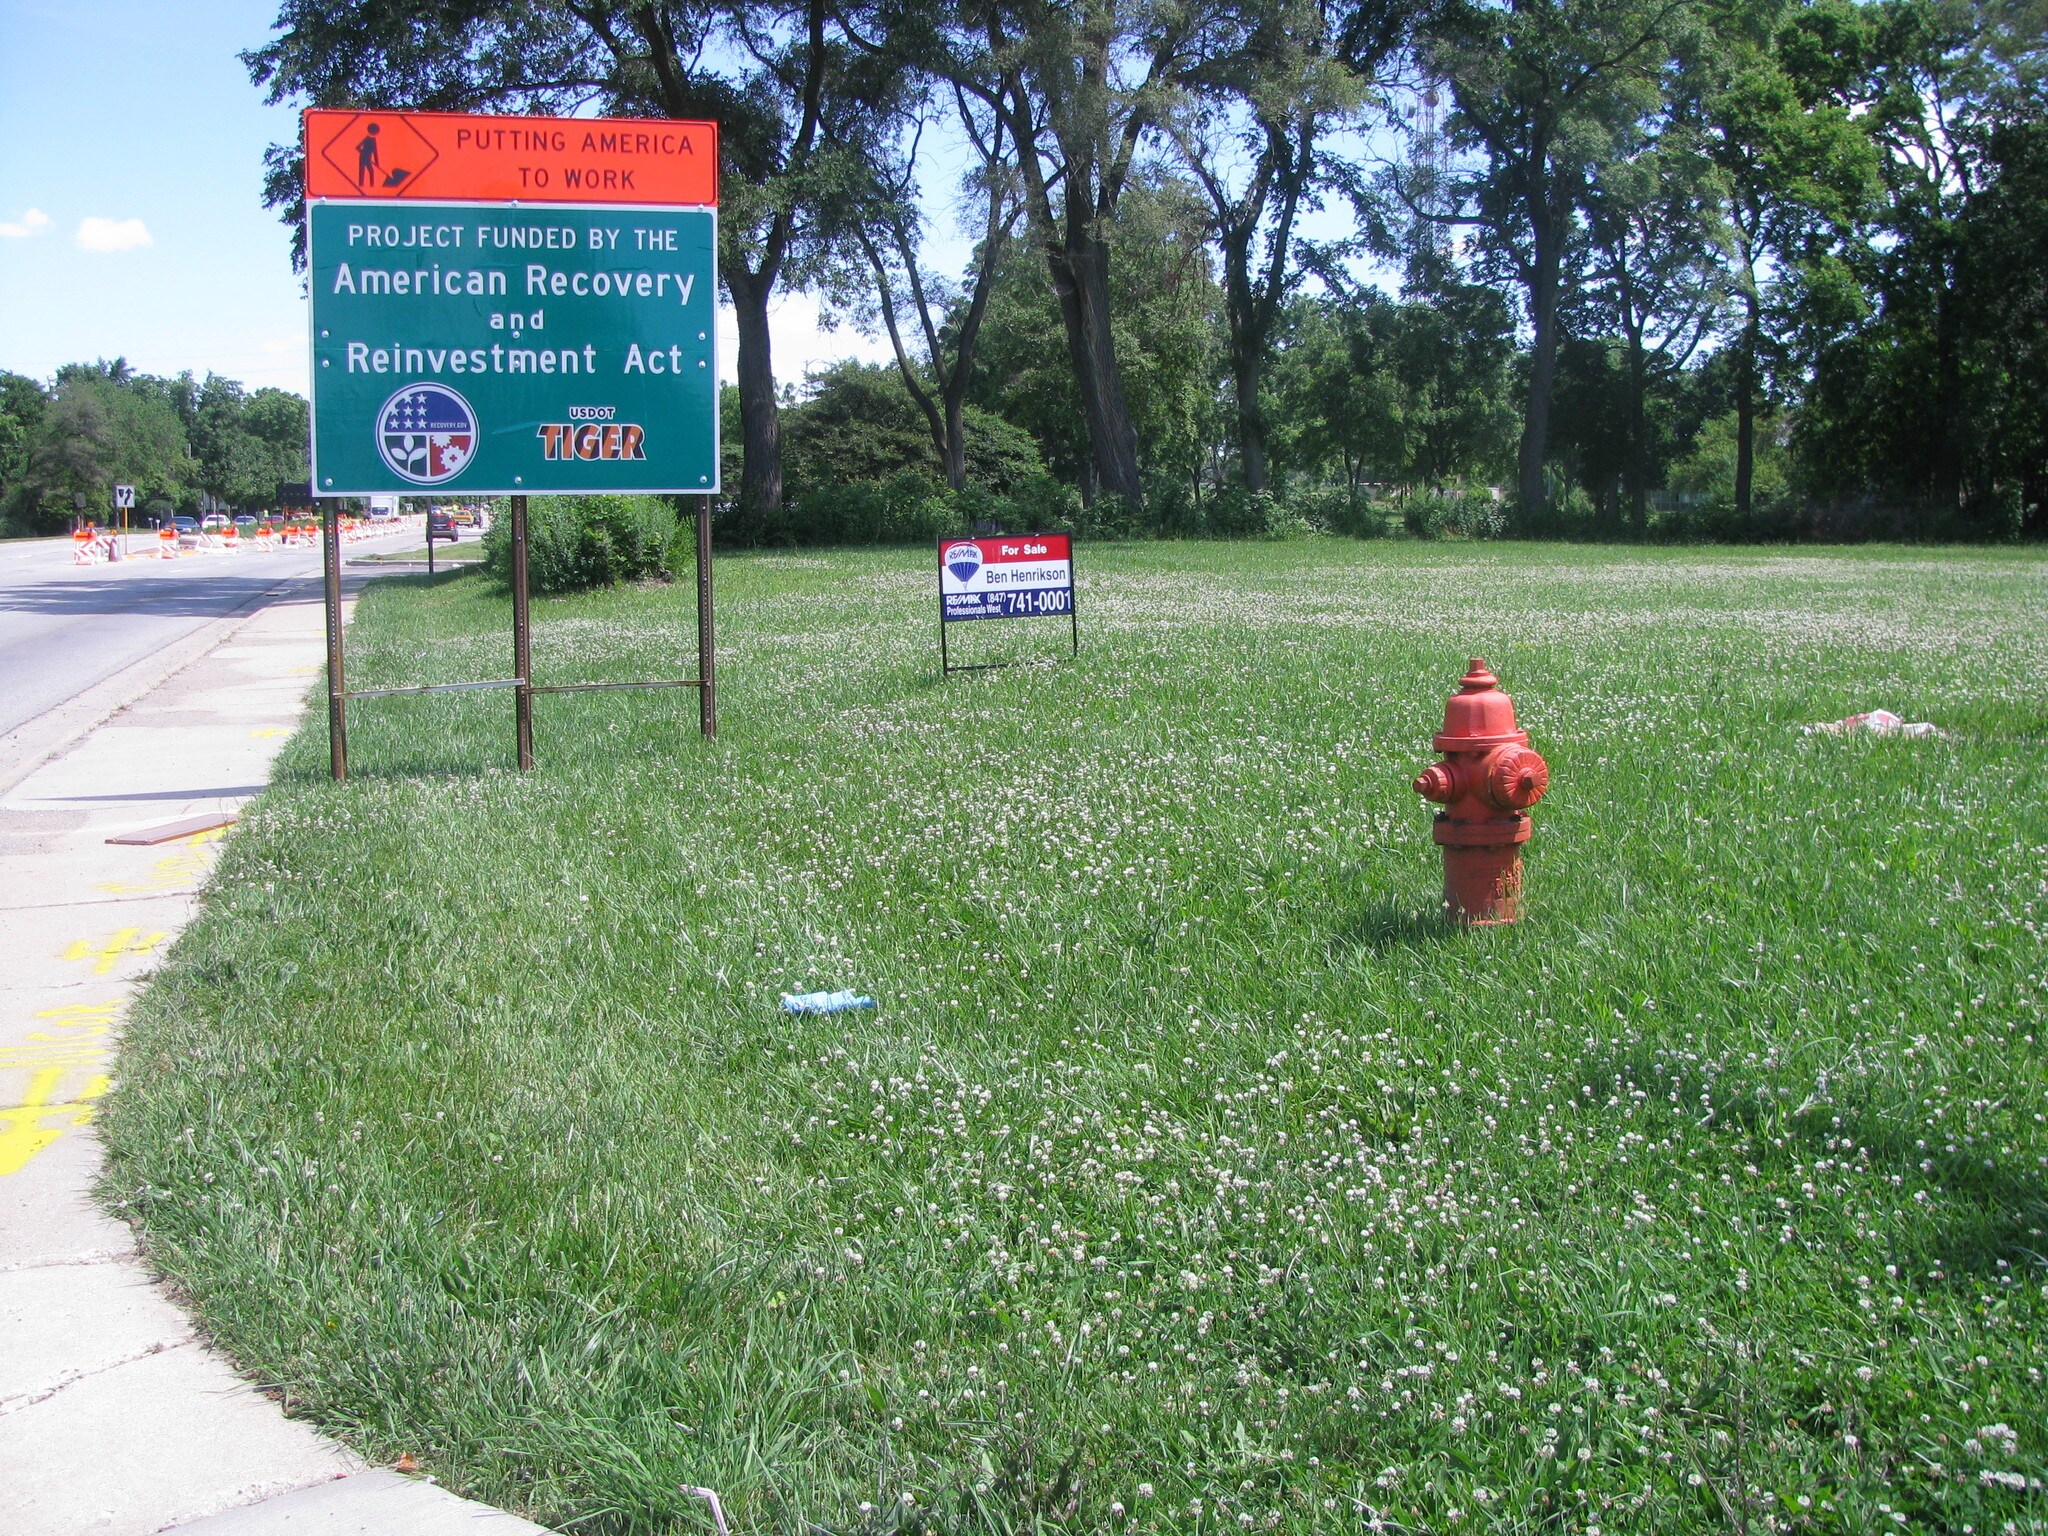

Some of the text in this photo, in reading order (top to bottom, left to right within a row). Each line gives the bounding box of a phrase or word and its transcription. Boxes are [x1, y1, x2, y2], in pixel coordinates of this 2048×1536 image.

[457, 129, 693, 155] PUTTING AMERICA
[519, 168, 635, 190] TO WORK
[348, 225, 678, 252] PROJECT FUNDED BY THE
[333, 263, 695, 306] American Recovery
[489, 309, 544, 330] and
[348, 342, 682, 375] Reinvestment Act
[568, 406, 615, 420] USDOT
[536, 423, 647, 461] TIGER
[949, 547, 978, 560] RE/MAX
[1001, 543, 1047, 556] For Sale
[986, 568, 1066, 584] Ben Henrikson
[946, 594, 981, 606] RE/MAX
[946, 604, 1001, 616] Professionals West
[987, 590, 1071, 613] (847) 741-0001
